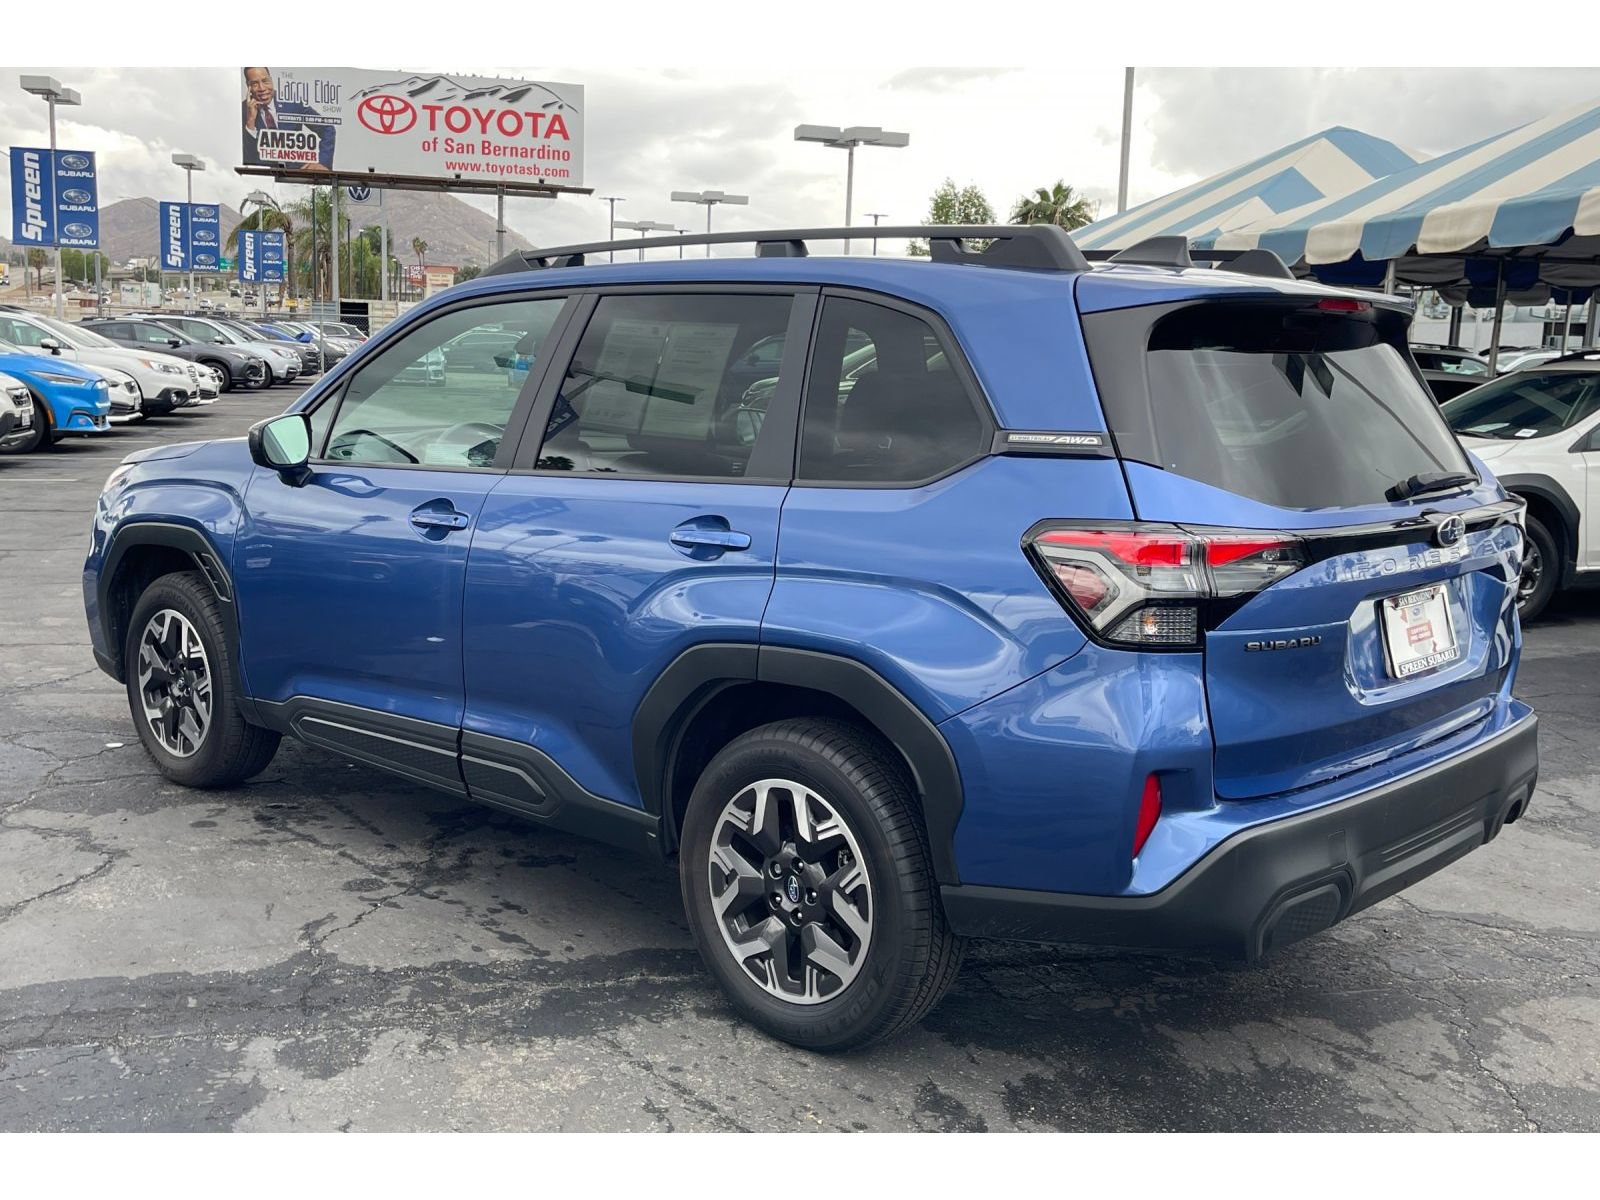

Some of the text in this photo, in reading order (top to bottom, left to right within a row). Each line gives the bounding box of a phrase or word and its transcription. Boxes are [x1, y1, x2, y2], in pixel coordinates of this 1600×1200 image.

[277, 77, 342, 105] Larry Elder
[421, 104, 570, 141] TOYOTA
[260, 131, 317, 150] AM590
[421, 137, 571, 162] of San Bernardino
[277, 151, 317, 161] ANSWER
[57, 170, 94, 178] SUBARU
[445, 160, 570, 178] www.toyotasb.com
[22, 152, 47, 241] Spreen
[167, 205, 185, 267] Spreen
[243, 232, 258, 281] Spreen
[1054, 436, 1098, 444] AWD
[1244, 635, 1322, 651] SUBARU
[1400, 649, 1456, 675] SPREEN SUBARU
